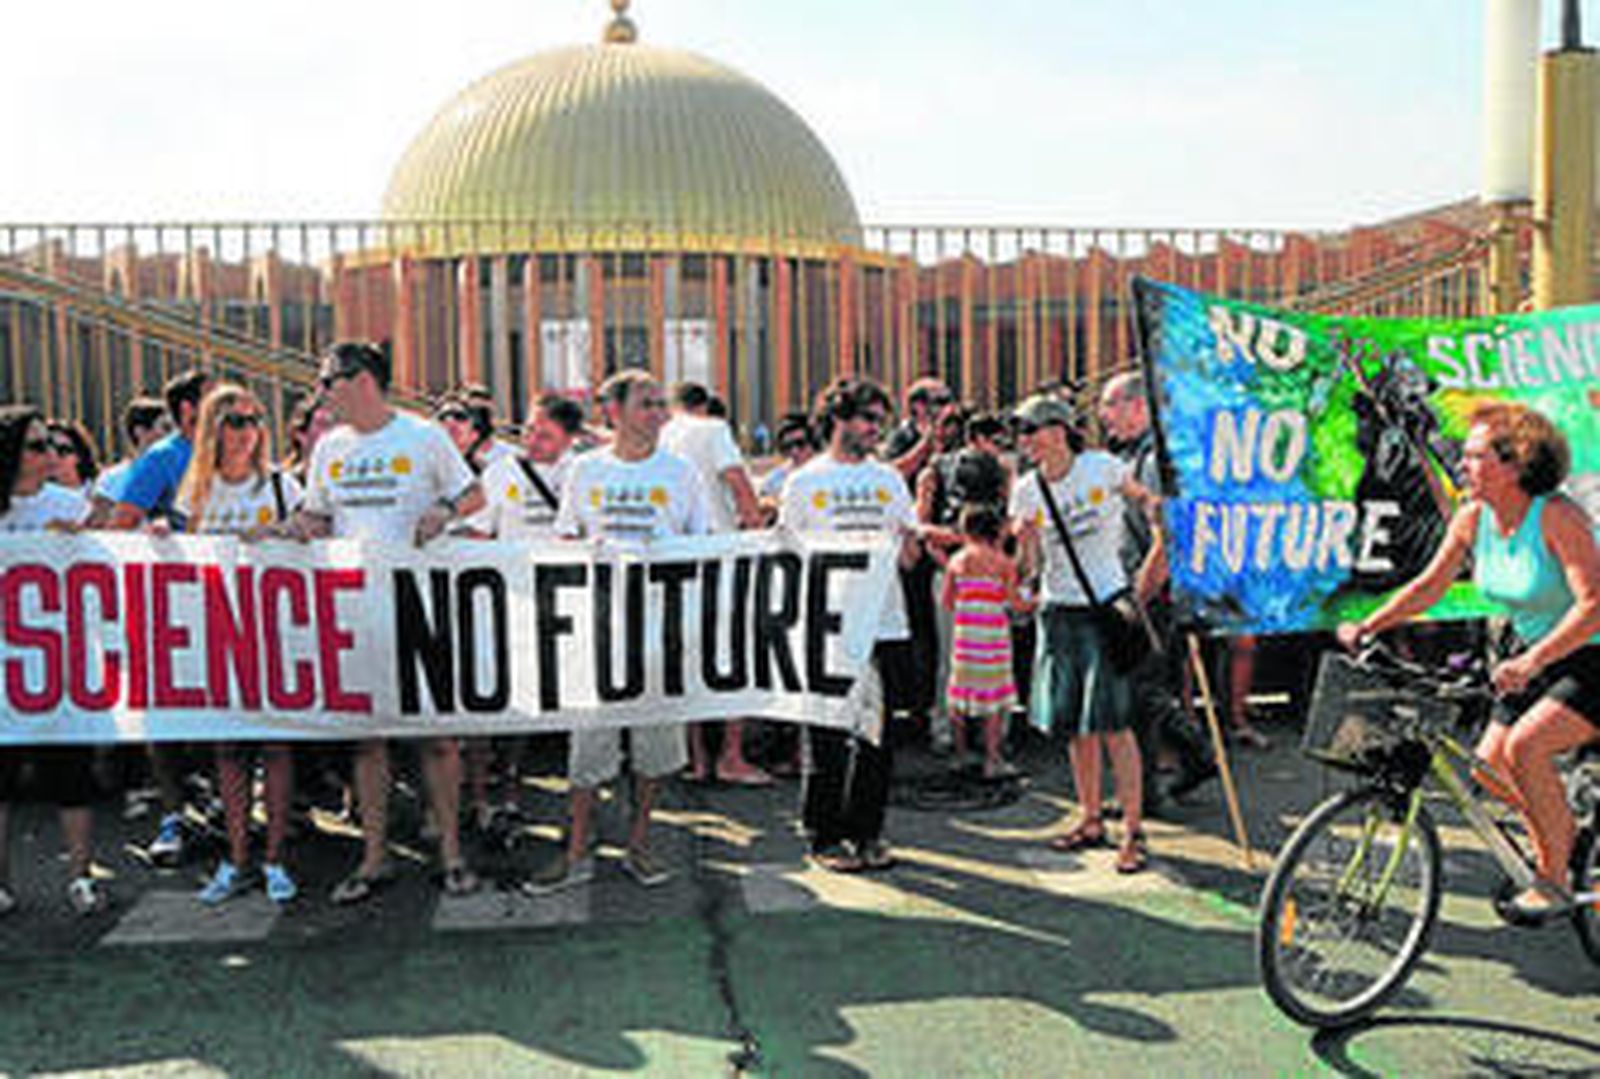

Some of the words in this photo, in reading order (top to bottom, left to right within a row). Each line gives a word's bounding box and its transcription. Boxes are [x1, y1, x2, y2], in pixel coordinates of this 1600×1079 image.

[1208, 304, 1309, 371] NO
[1210, 409, 1306, 484] NO
[1190, 500, 1400, 574] FUTURE
[1, 562, 373, 714] SCIENCE
[393, 566, 511, 715] NO
[534, 552, 870, 712] FUTURE
